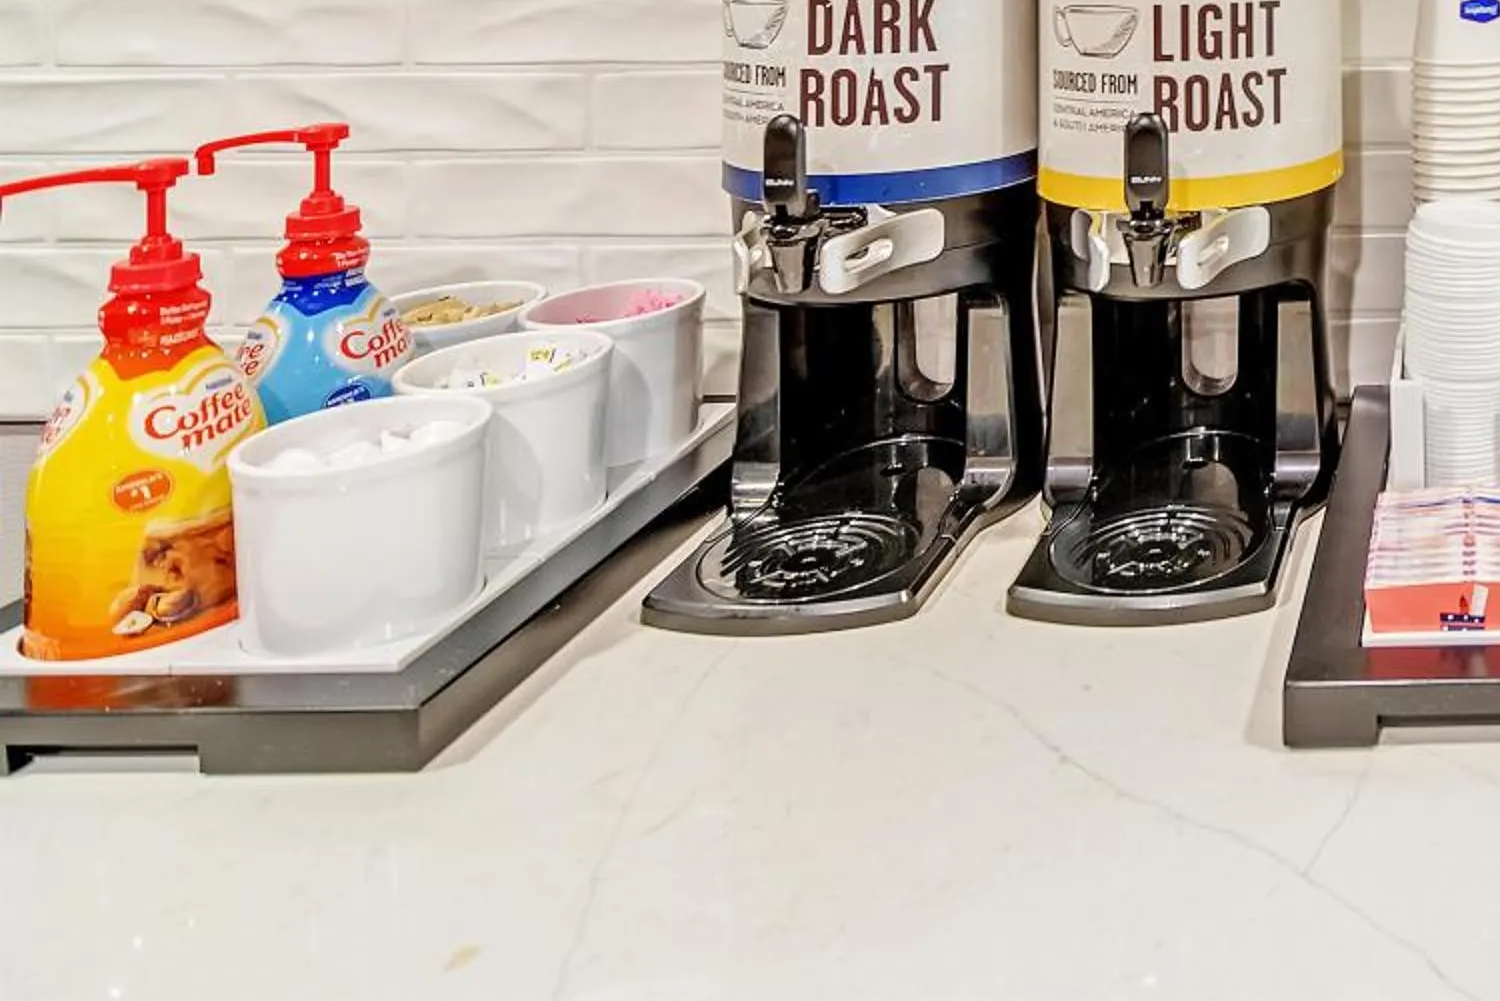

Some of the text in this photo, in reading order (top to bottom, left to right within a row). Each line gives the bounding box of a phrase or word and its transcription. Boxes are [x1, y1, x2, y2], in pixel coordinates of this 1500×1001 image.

[1153, 0, 1280, 62] LIGHT
[755, 64, 786, 88] FROM
[800, 63, 949, 127] ROAST
[1053, 69, 1137, 95] SOURCED FROM
[1153, 68, 1287, 133] ROAST
[144, 383, 245, 440] Coffee
[181, 399, 251, 449] mate
